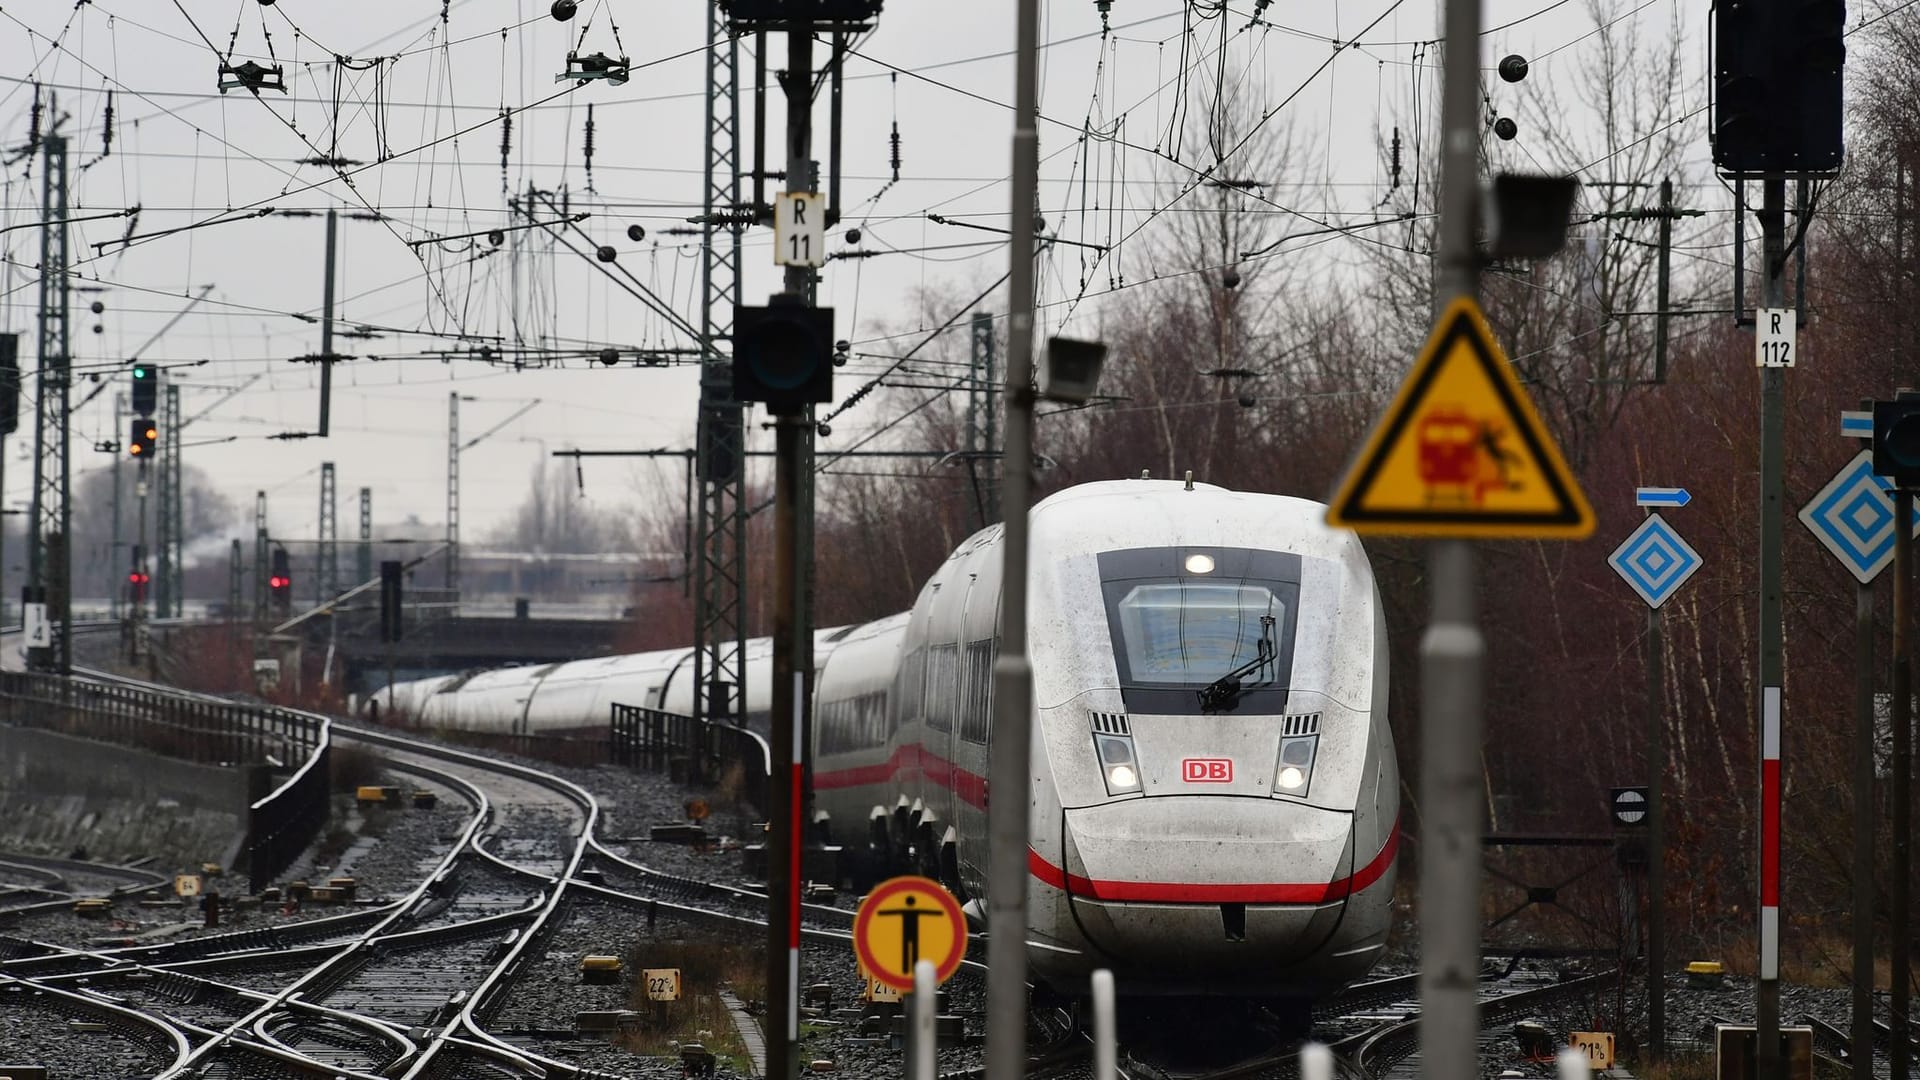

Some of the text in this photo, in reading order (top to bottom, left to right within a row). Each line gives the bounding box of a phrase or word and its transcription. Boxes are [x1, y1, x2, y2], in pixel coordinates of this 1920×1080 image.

[794, 198, 806, 225] R
[789, 233, 810, 261] 11
[1771, 313, 1782, 335] R
[1761, 341, 1790, 363] 112
[1187, 761, 1228, 780] DB
